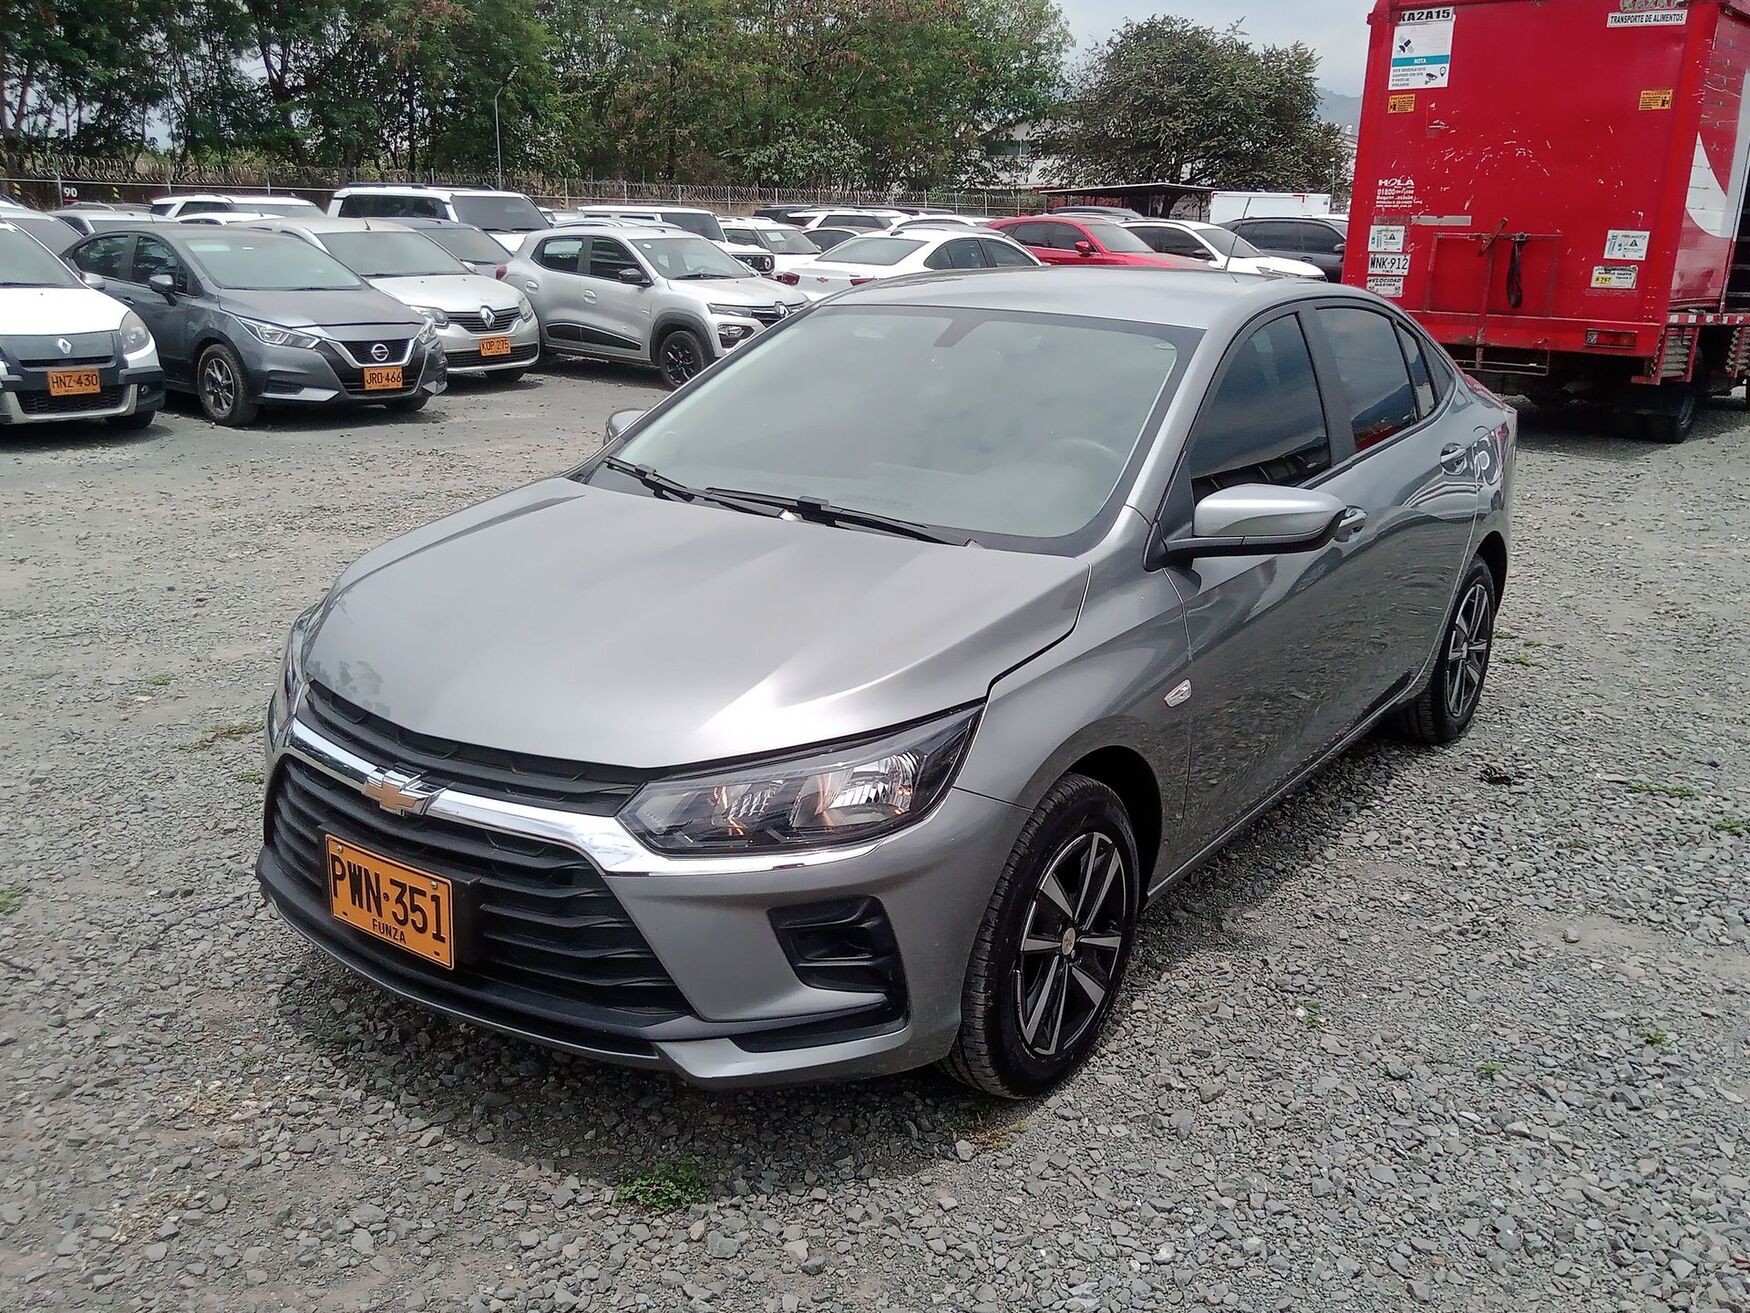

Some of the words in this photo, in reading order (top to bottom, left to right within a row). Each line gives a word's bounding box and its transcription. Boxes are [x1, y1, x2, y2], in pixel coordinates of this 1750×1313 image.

[1611, 15, 1645, 24] TRANSPORTE
[1646, 15, 1653, 23] DE
[1653, 13, 1684, 22] ALIMENTOS
[1378, 178, 1415, 187] HOLA
[64, 187, 78, 198] 90
[371, 917, 407, 945] FUNZA
